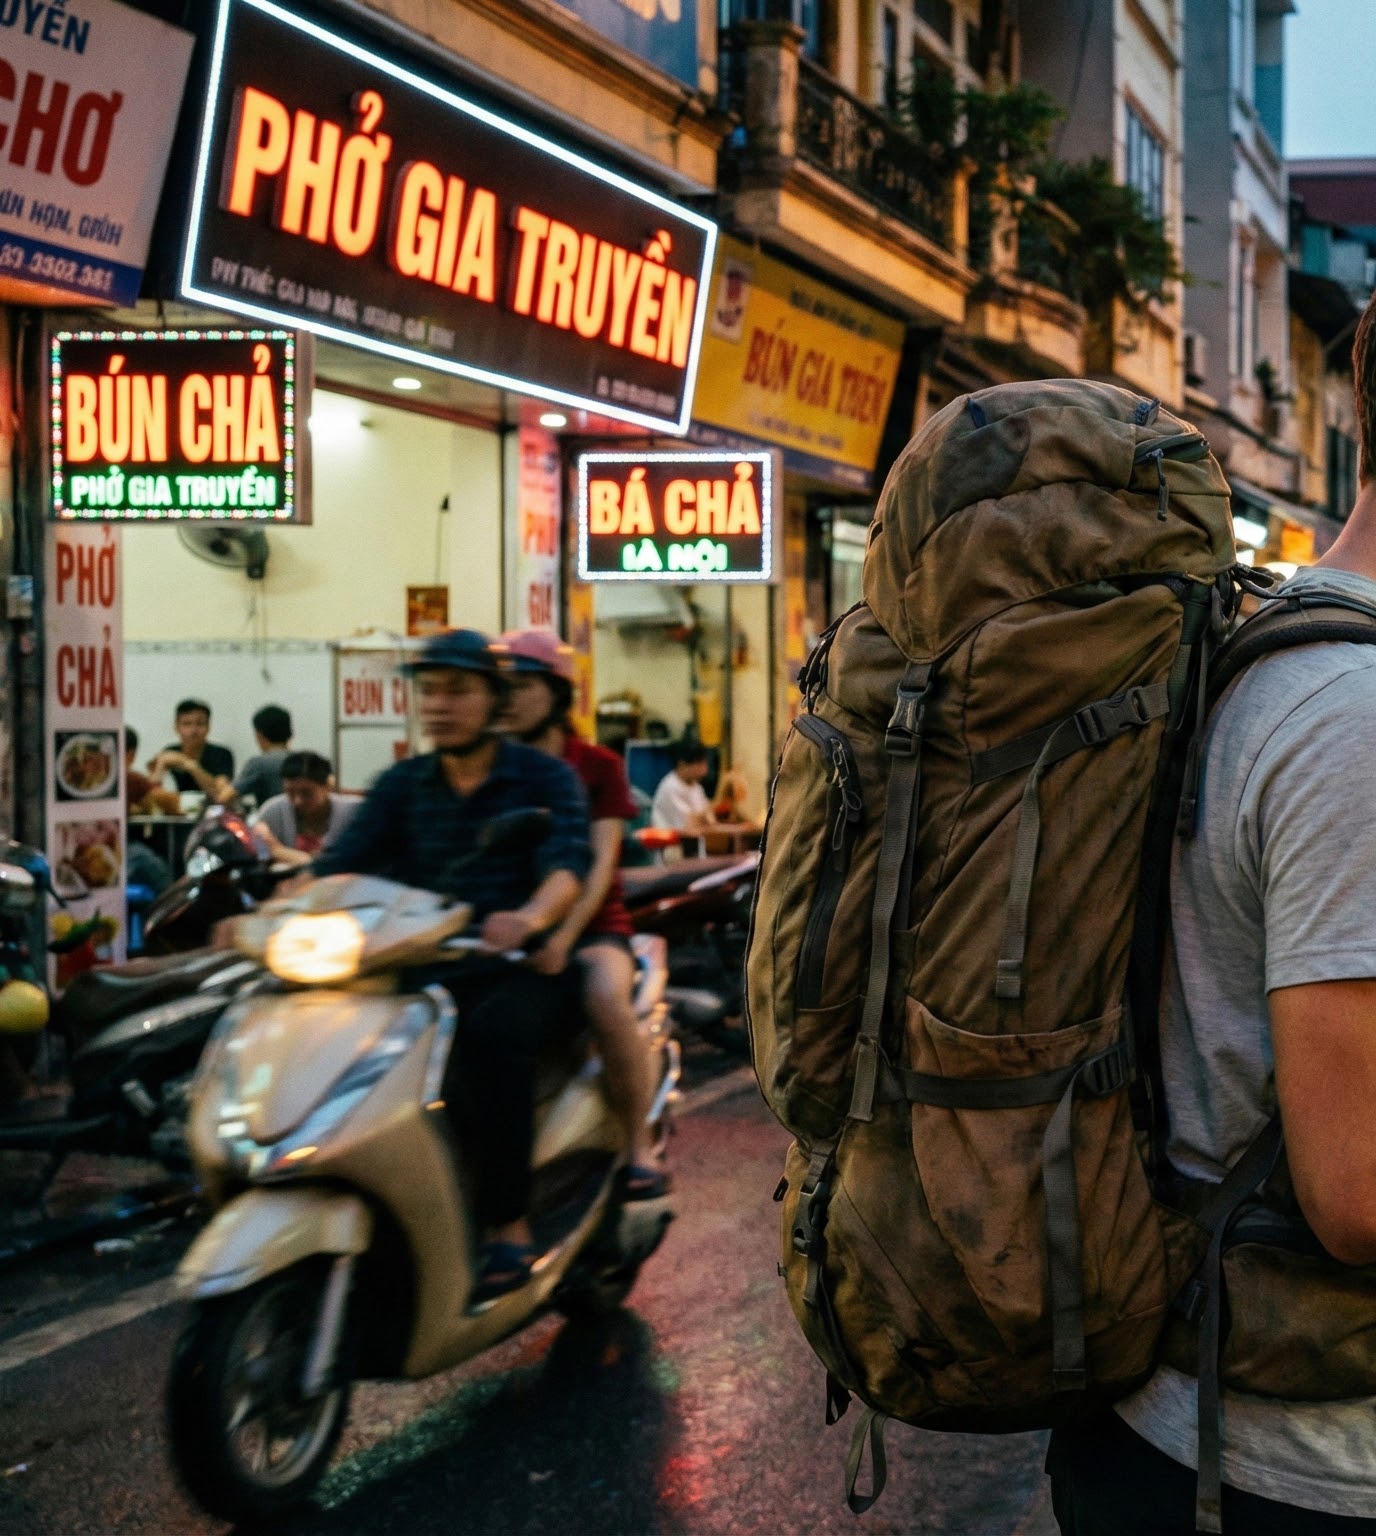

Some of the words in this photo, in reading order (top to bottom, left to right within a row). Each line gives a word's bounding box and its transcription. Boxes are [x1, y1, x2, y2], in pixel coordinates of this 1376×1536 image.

[228, 86, 393, 258] PHỞ
[395, 160, 496, 303] GIA
[66, 355, 168, 462] BÚN
[180, 344, 281, 462] CHẢ
[71, 465, 125, 506] PHỞ
[128, 475, 173, 506] GIA
[589, 466, 655, 535] BÁ
[663, 461, 761, 535] CHẢ
